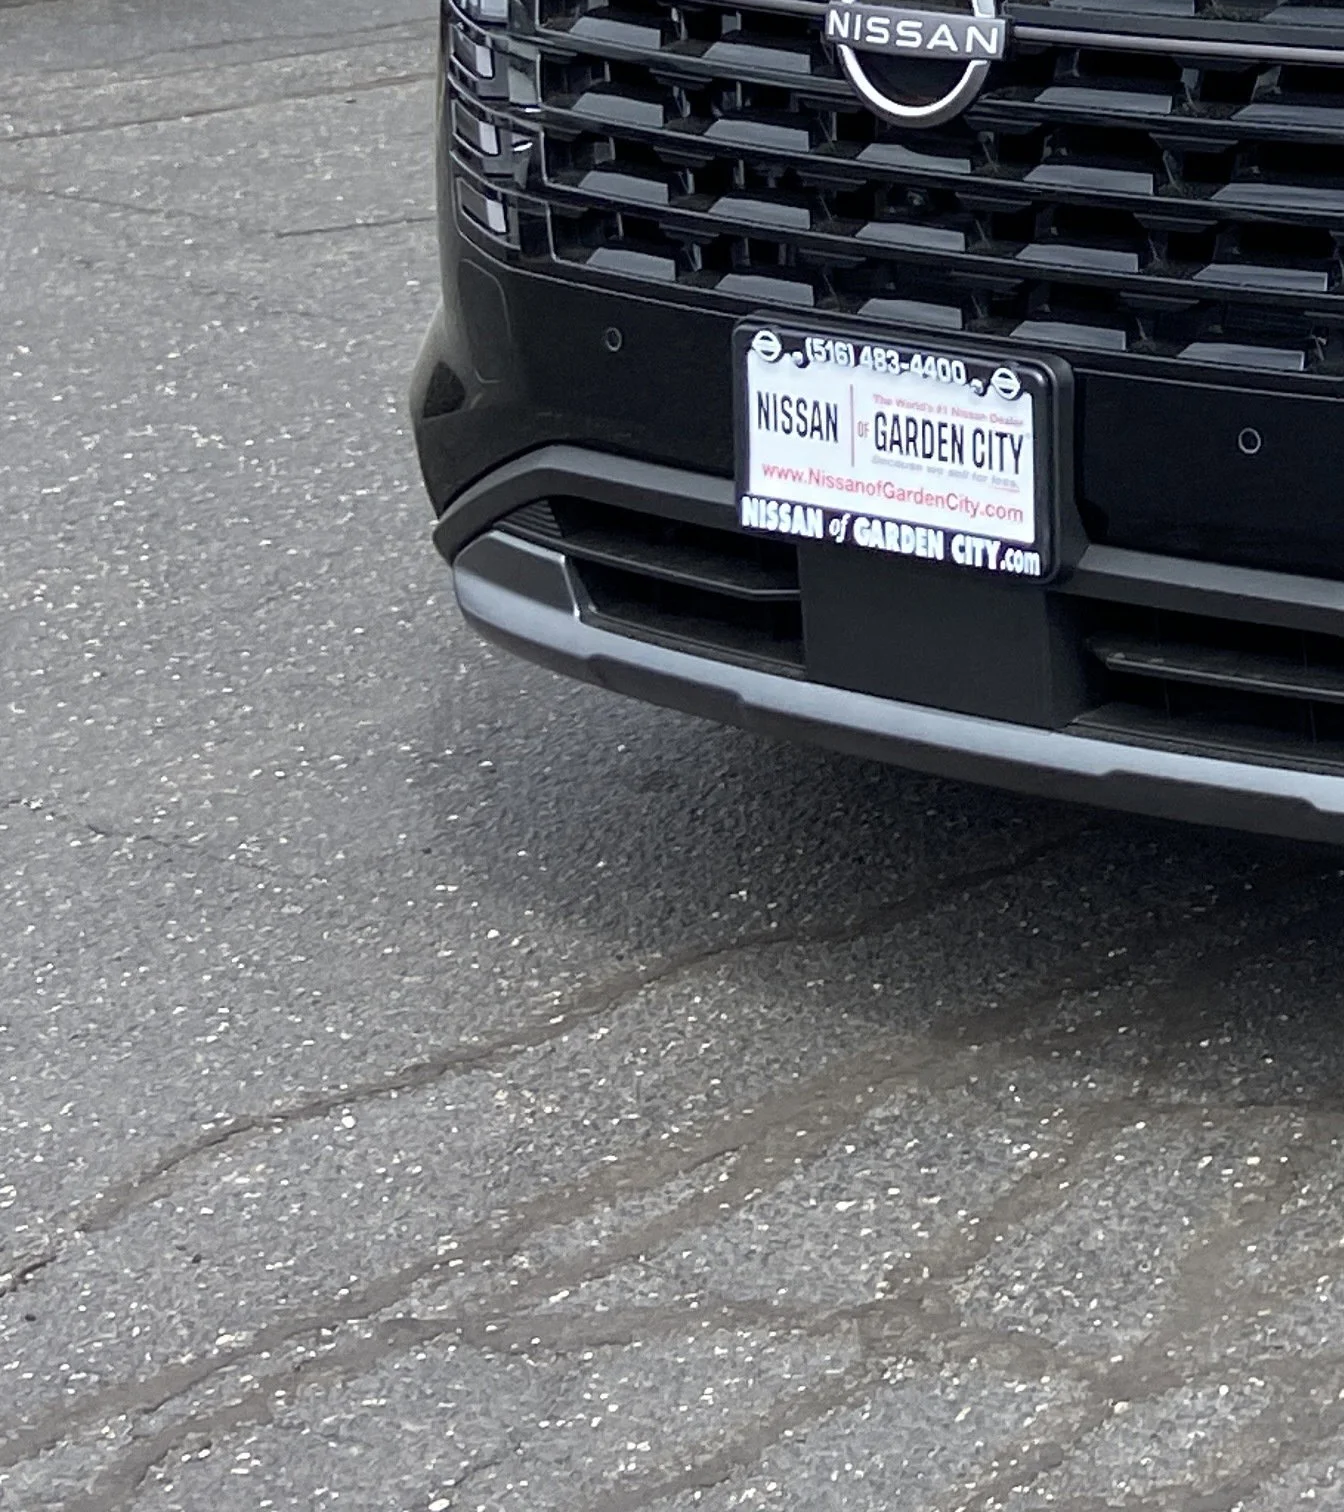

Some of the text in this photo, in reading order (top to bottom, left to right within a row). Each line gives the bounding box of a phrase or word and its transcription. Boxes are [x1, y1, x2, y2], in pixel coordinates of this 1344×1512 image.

[828, 9, 999, 54] NISSAN
[805, 336, 967, 386] (516) 483-4400
[757, 390, 839, 444] NISSAN
[872, 393, 893, 406] The
[951, 406, 988, 421] Nissan
[857, 410, 1024, 476] OF GARDEN CITY
[761, 461, 1024, 524] www.NissanofGardenCity.com
[741, 496, 1041, 577] NISSAN of GARDEN CITY.com
